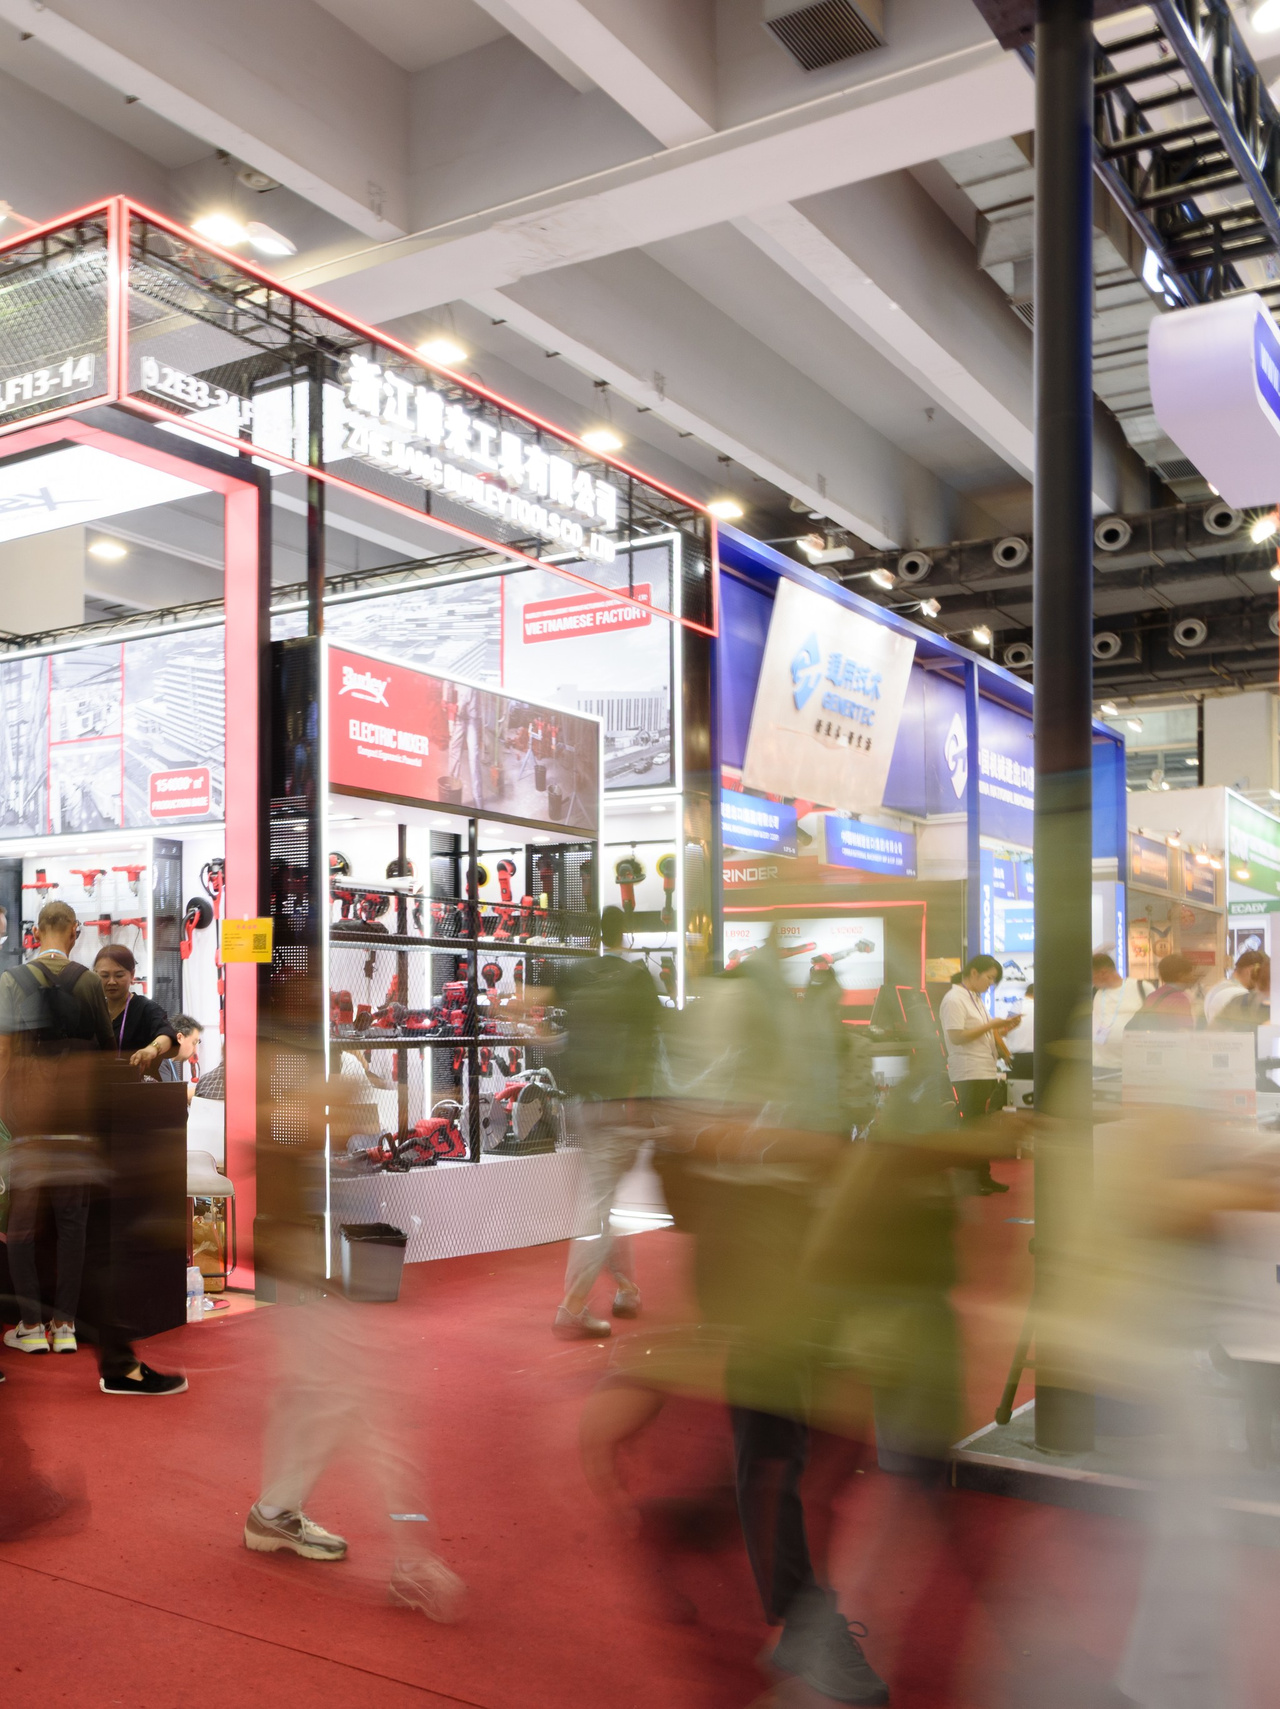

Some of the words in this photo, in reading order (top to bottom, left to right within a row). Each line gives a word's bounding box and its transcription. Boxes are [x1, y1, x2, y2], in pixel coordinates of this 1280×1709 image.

[347, 423, 444, 486] ZHEJIANG
[510, 494, 561, 539] TOOLS
[524, 613, 594, 636] VIETNAMESE
[595, 605, 647, 626] FACTORY
[821, 690, 876, 727] GENERTEC
[349, 718, 397, 749] ELECTRIC
[397, 730, 429, 756] MIXER
[1231, 903, 1267, 914] ECADY
